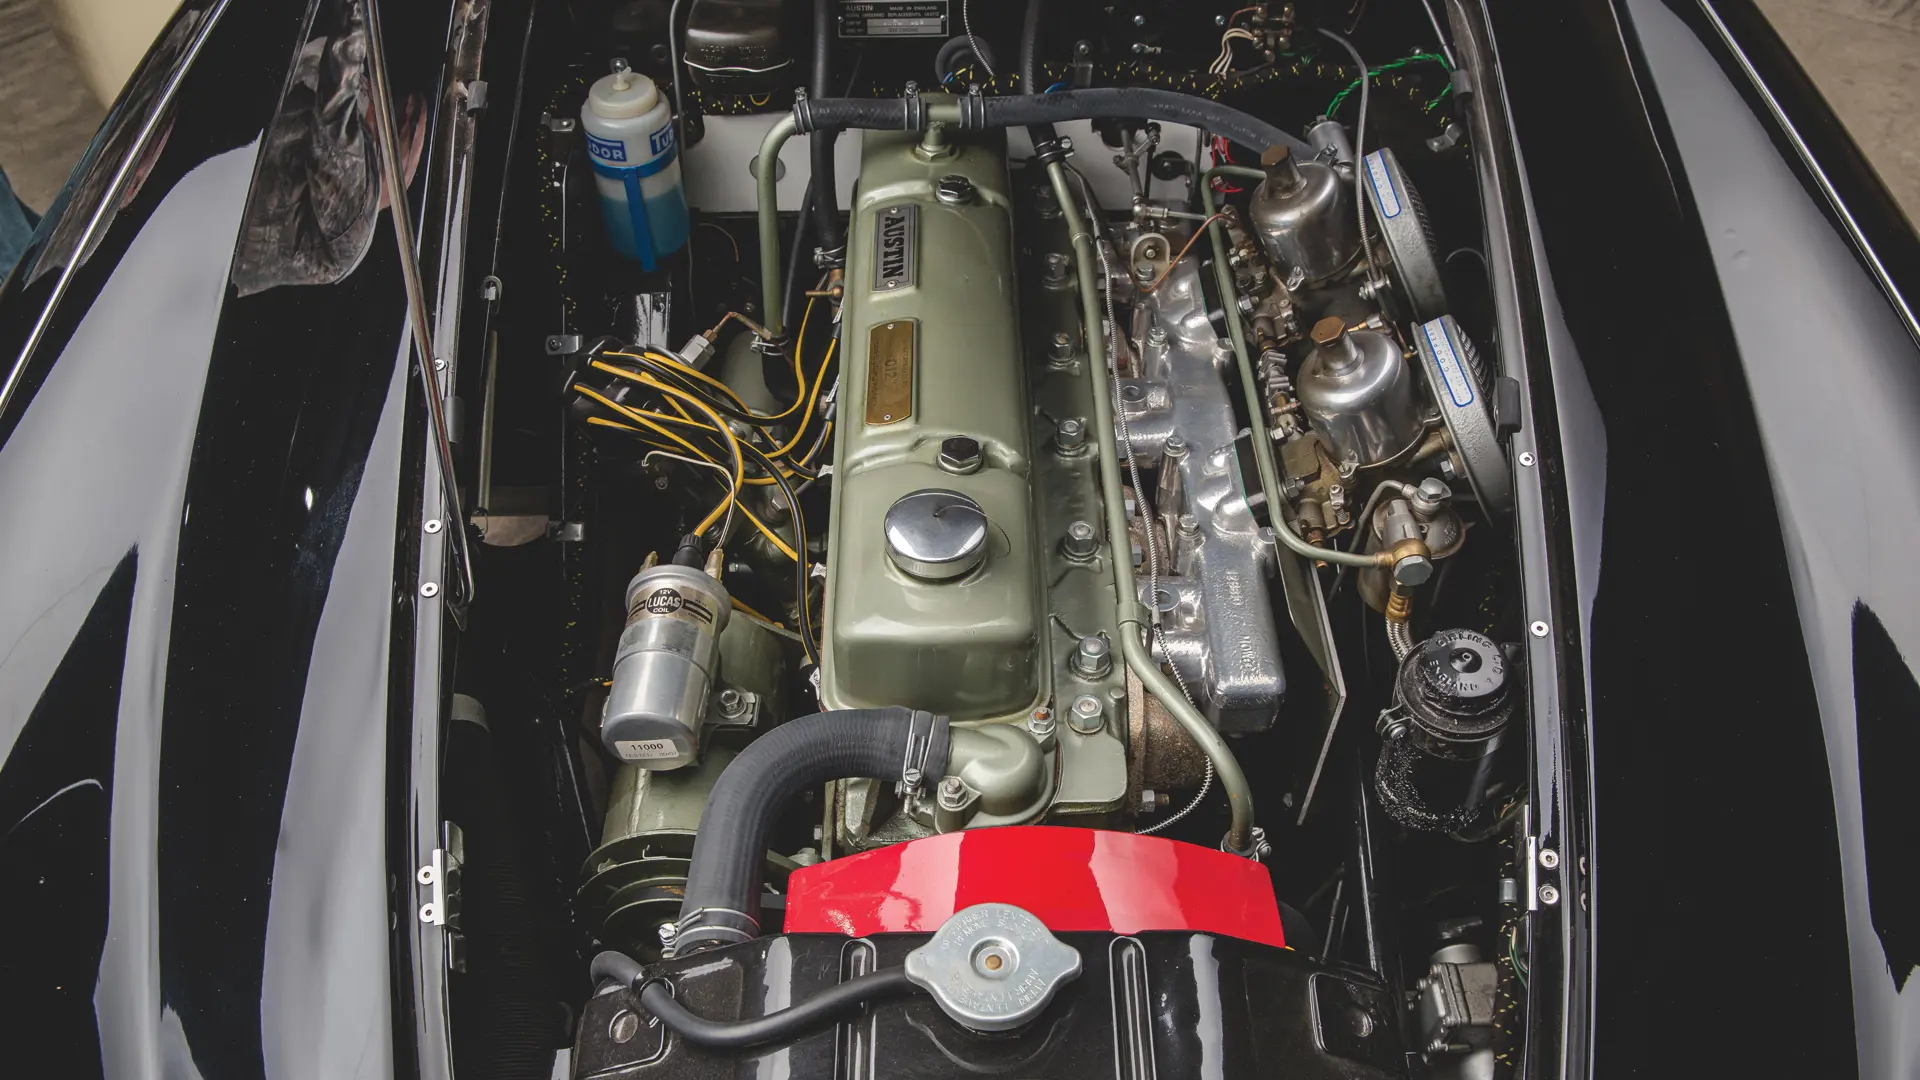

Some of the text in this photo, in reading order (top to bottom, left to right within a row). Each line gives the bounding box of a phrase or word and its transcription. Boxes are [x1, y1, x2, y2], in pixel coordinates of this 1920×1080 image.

[845, 4, 874, 12] AUSTIN
[587, 142, 624, 160] DOR
[882, 216, 905, 280] AUSTIN
[647, 595, 681, 608] LUCAS
[630, 743, 664, 751] 11000
